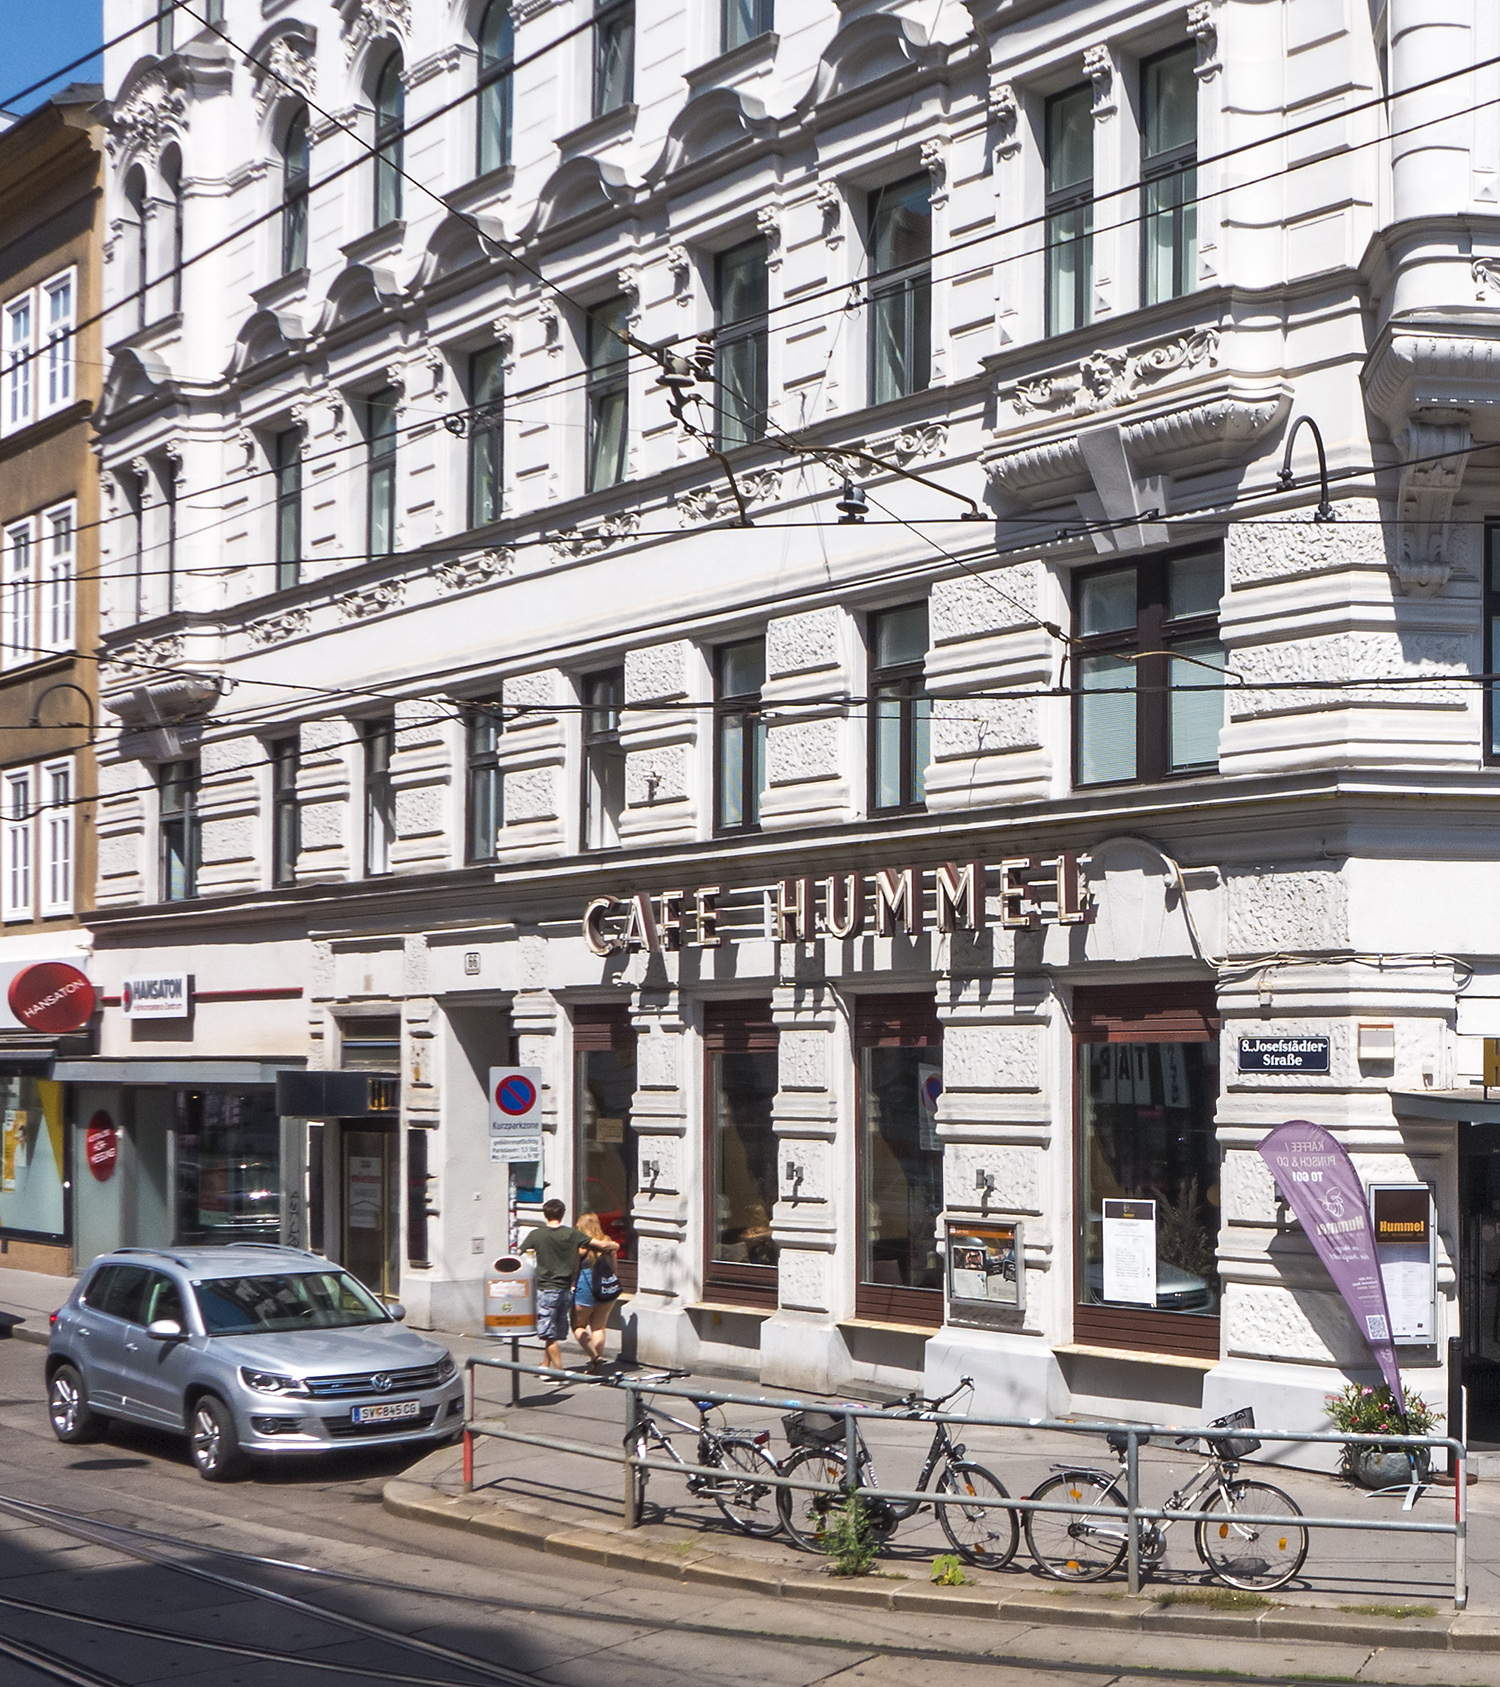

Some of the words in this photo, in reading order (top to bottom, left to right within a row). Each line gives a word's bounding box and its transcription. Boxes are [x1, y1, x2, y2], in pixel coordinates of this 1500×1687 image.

[582, 886, 722, 957] CAFE
[776, 854, 1092, 942] HUMMEL
[133, 979, 183, 999] HANSATON
[24, 979, 87, 1018] HANSATON
[1263, 1053, 1303, 1066] Straße
[492, 1121, 539, 1130] Kurzparkzone
[1379, 1220, 1424, 1232] Hummel
